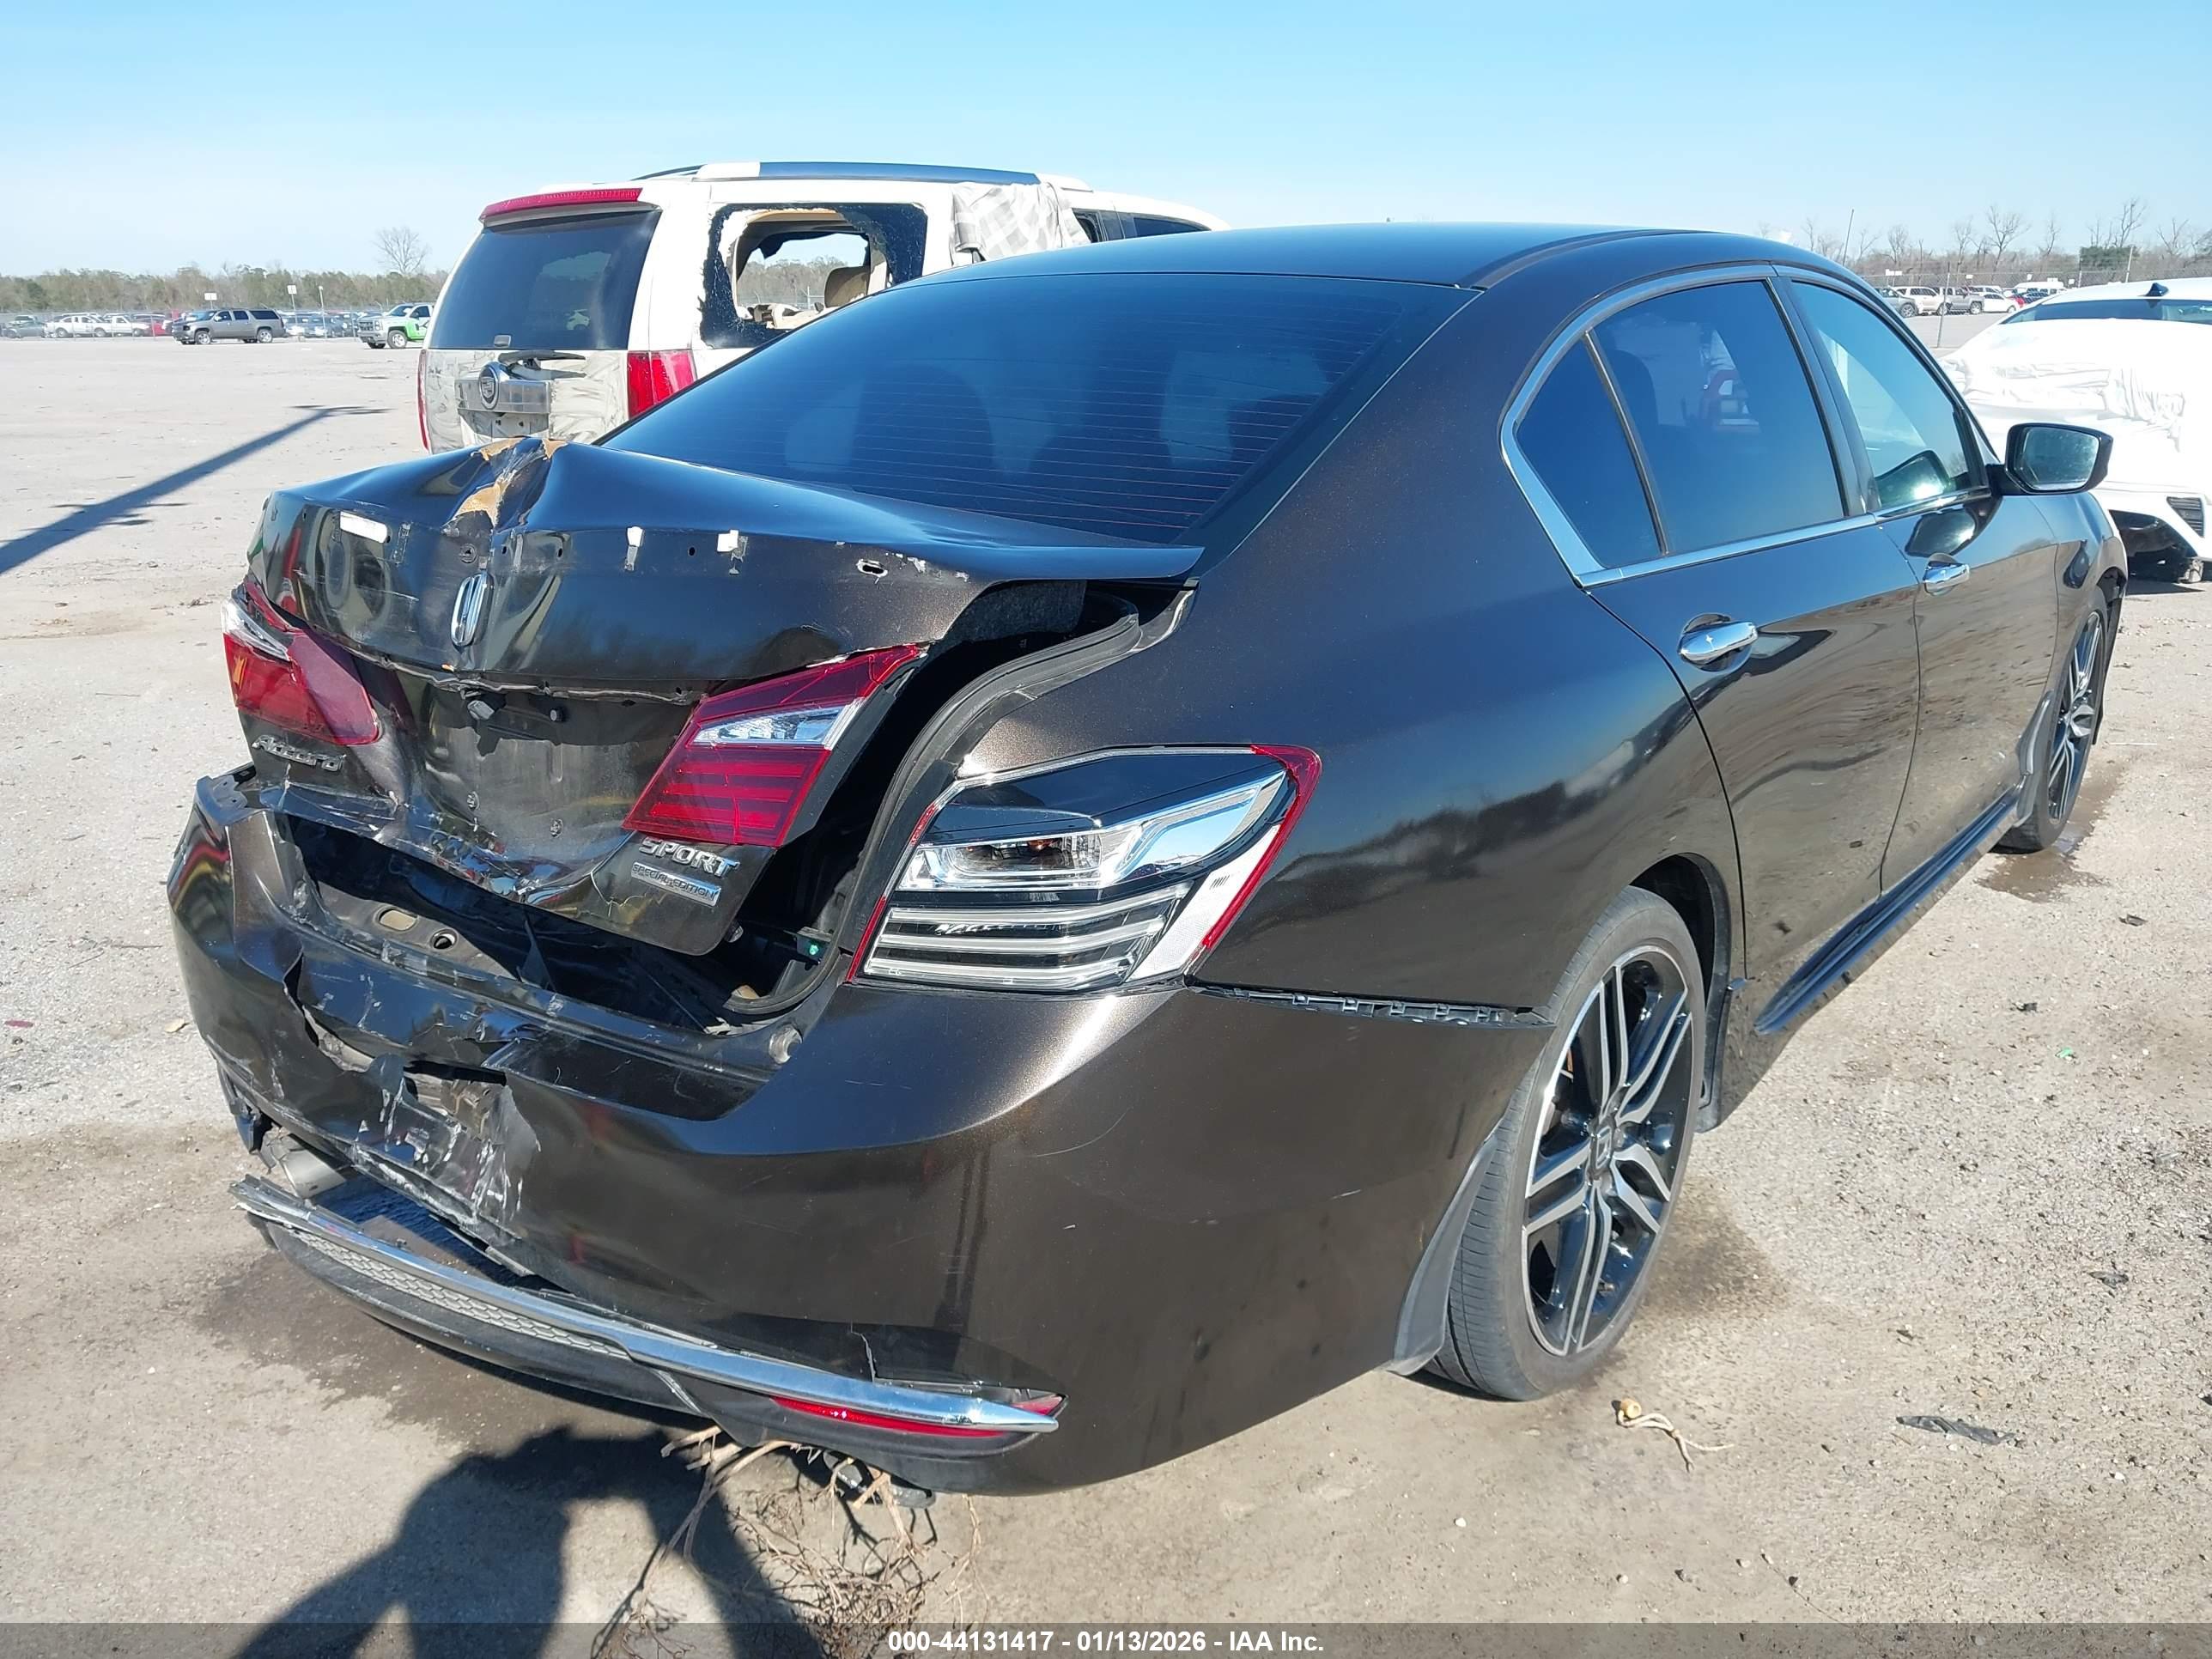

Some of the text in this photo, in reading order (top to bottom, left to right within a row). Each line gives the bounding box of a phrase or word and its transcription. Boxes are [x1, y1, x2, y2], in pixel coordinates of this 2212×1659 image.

[638, 836, 740, 878] SPORT
[632, 863, 715, 900] SPECIAL EDITION
